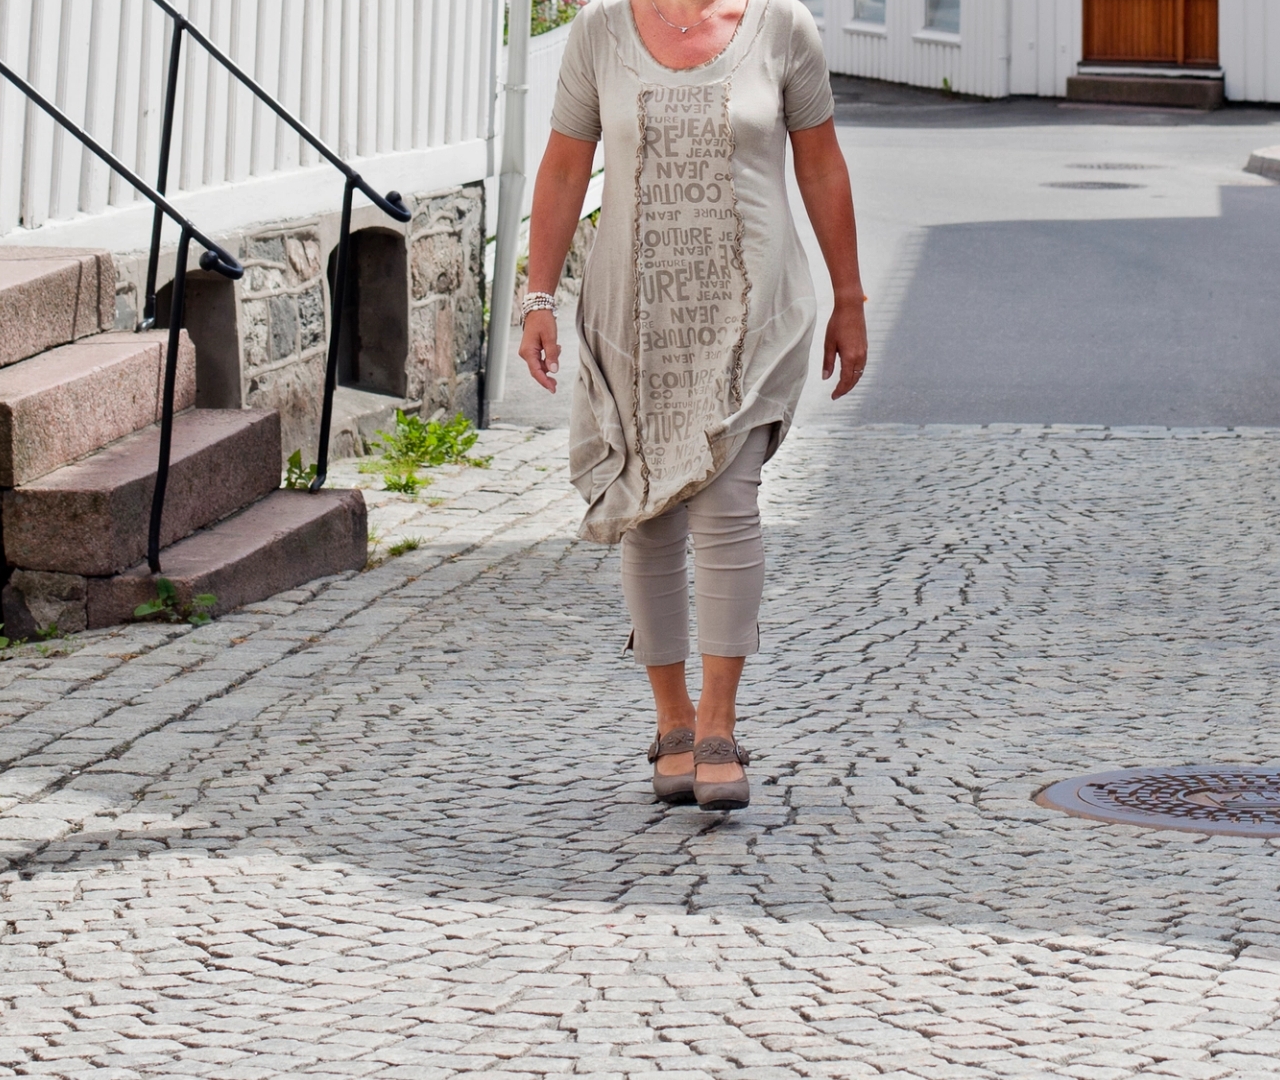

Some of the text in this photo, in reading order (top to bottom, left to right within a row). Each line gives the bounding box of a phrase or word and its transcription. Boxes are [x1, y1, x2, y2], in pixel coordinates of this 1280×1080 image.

[665, 104, 712, 114] JEAN
[692, 138, 728, 147] JEAN
[686, 147, 726, 158] JEAN
[656, 160, 709, 181] JEAN
[645, 210, 681, 221] JEAN
[673, 246, 712, 256] JEAN
[700, 280, 731, 289] JEAN
[697, 291, 732, 301] JEAN
[670, 305, 719, 324] JEAN
[641, 327, 727, 352] COUTURE
[662, 353, 695, 364] JEAN
[649, 368, 716, 390] COUTURE
